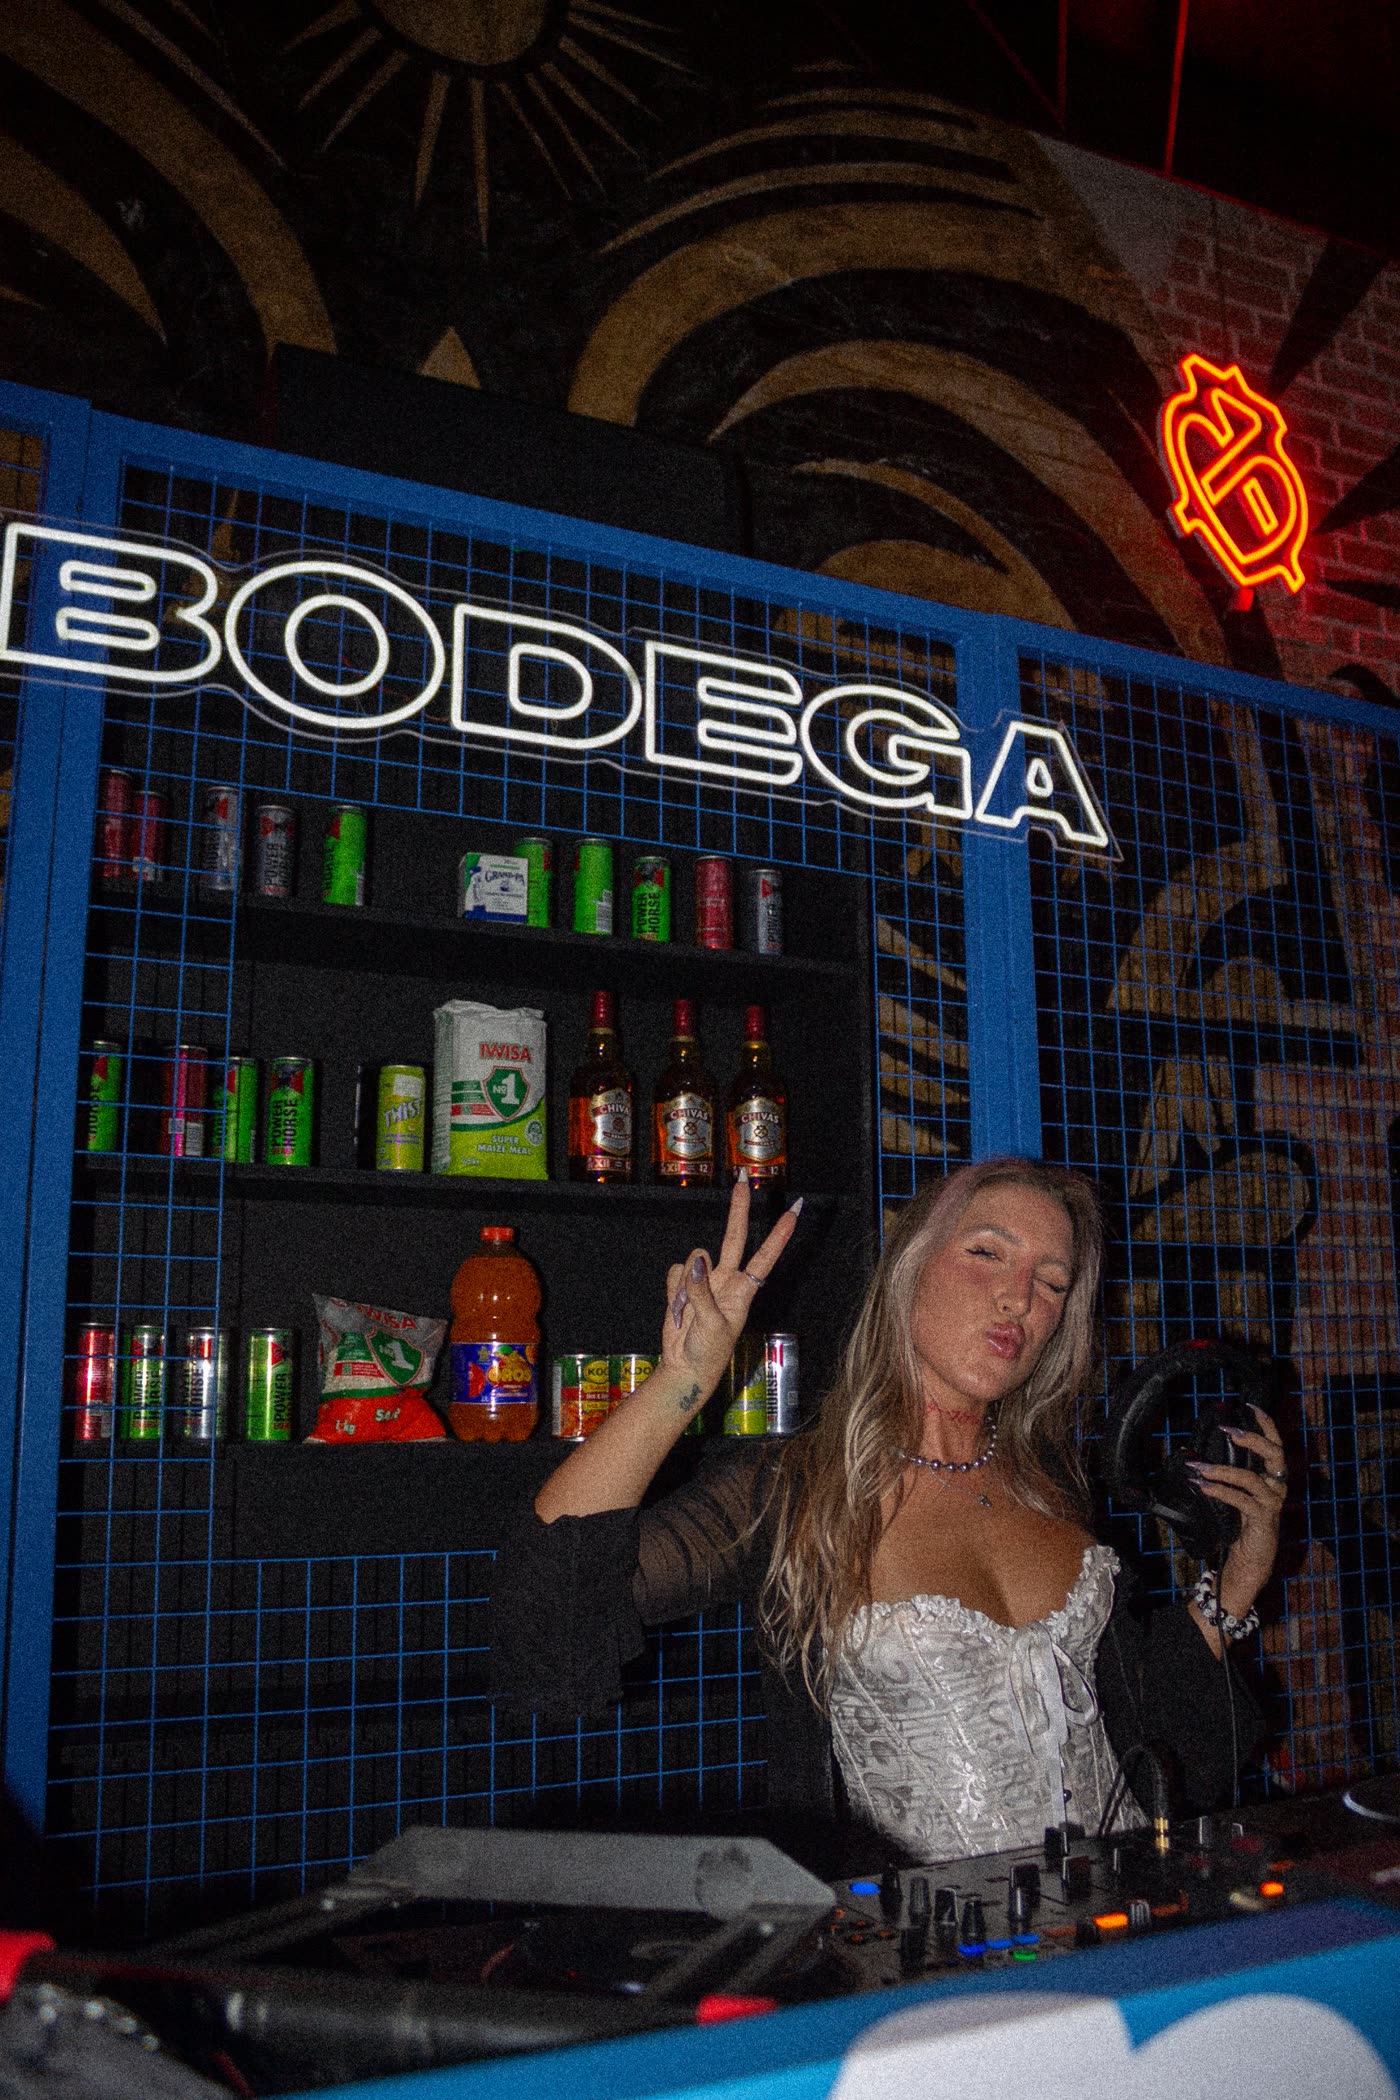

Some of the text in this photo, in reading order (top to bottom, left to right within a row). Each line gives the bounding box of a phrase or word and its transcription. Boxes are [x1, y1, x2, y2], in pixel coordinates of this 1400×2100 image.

[0, 522, 1109, 847] BODEGA
[647, 892, 660, 934] HORSE
[480, 1042, 531, 1063] IWISA
[271, 1099, 282, 1147] POWER
[284, 1099, 297, 1148] HORSE
[599, 1103, 630, 1115] CHIVA
[669, 1108, 708, 1121] CHIVAS
[741, 1112, 779, 1124] CHIVAS
[491, 1135, 520, 1144] SUPER
[274, 1372, 286, 1423] POWER
[767, 1371, 778, 1415] HORSE
